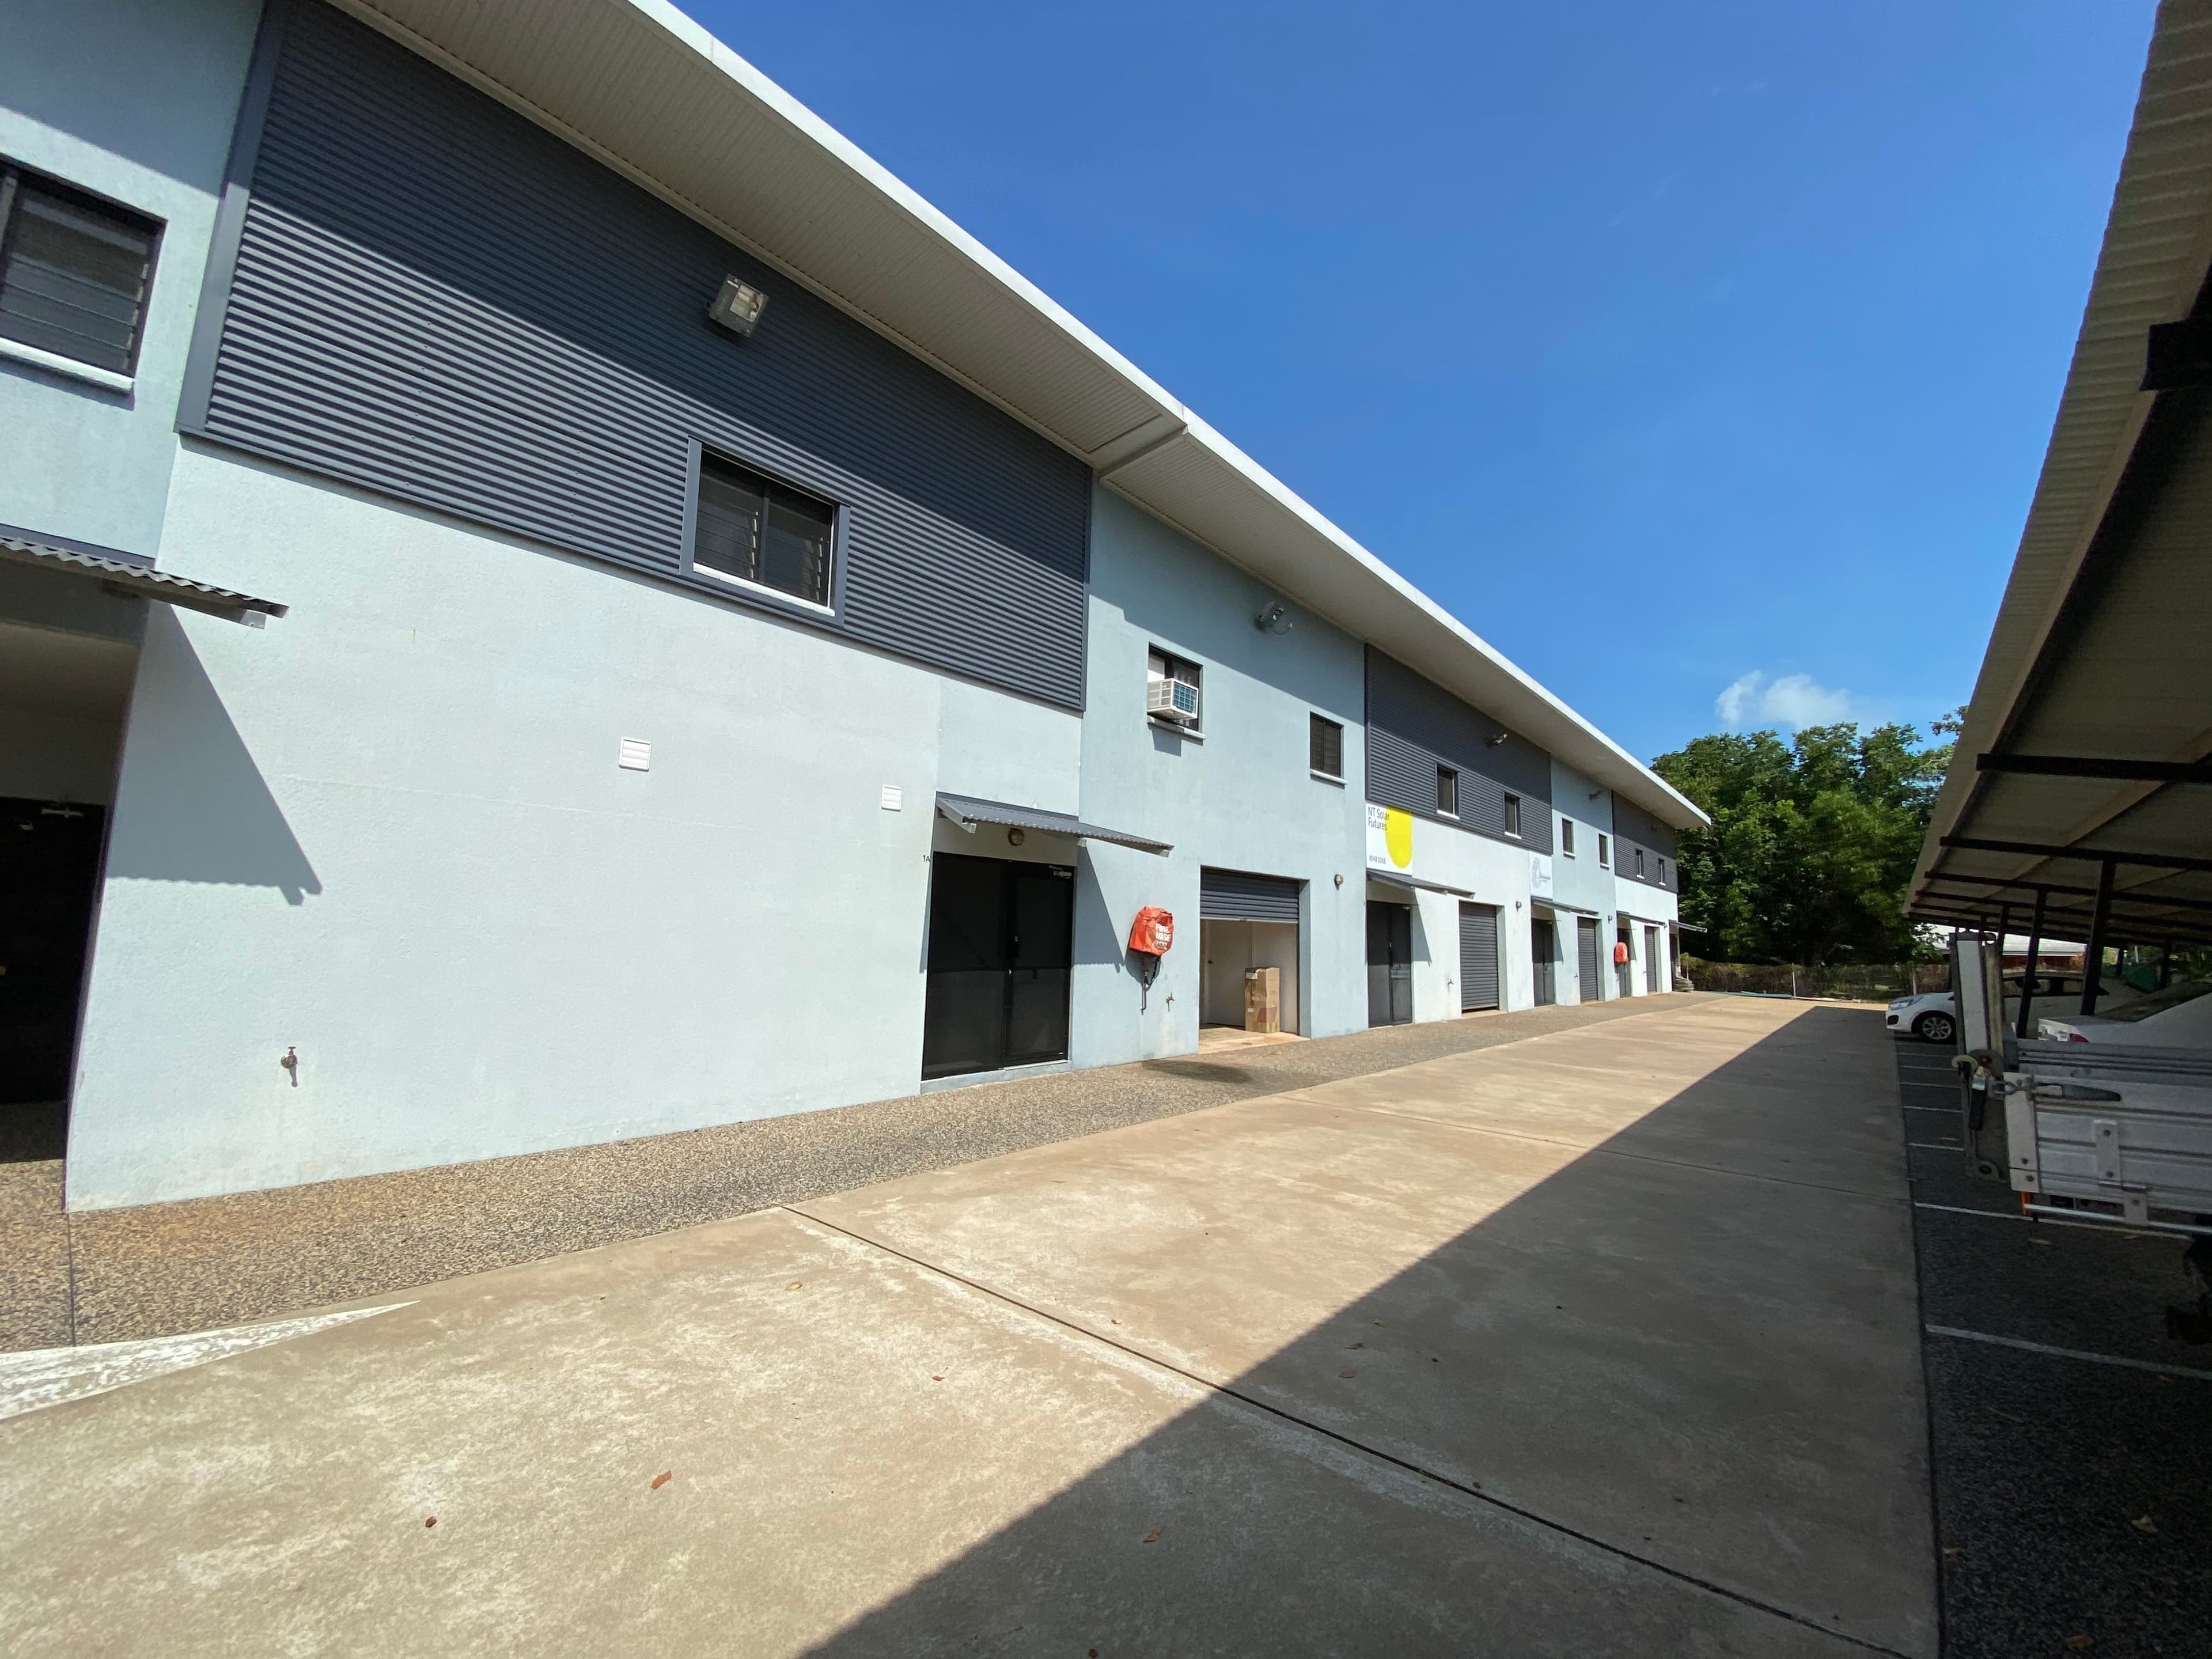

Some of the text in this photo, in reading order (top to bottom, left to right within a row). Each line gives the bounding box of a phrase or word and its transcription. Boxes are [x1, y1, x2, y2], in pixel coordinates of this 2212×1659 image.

[1368, 806, 1389, 820] NT Solar
[1368, 817, 1387, 830] Futures
